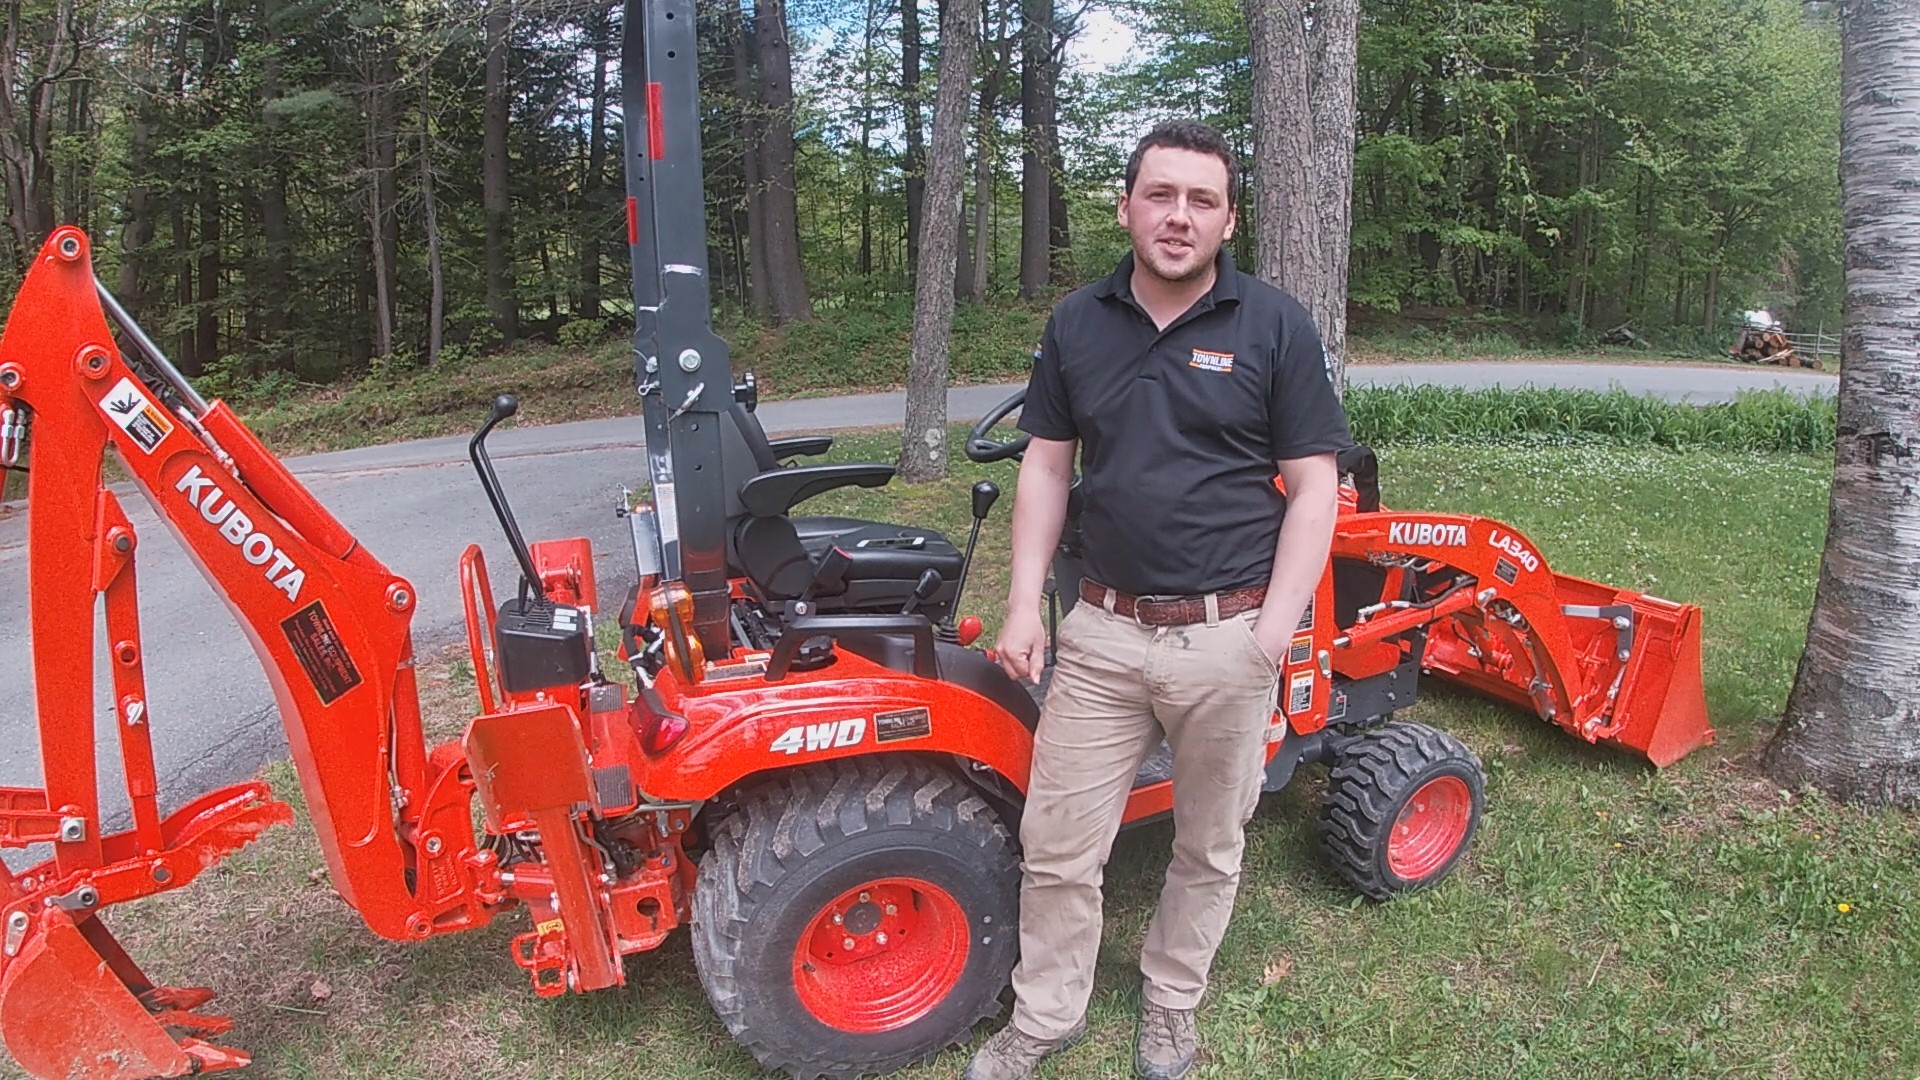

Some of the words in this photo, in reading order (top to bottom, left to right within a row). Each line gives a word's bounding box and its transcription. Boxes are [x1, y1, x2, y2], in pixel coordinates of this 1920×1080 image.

[1191, 352, 1234, 367] TOWNLINE
[174, 464, 306, 602] KUBOTA
[1388, 521, 1467, 546] KUBOTA
[1488, 530, 1538, 572] LA340
[769, 718, 867, 754] 4WD
